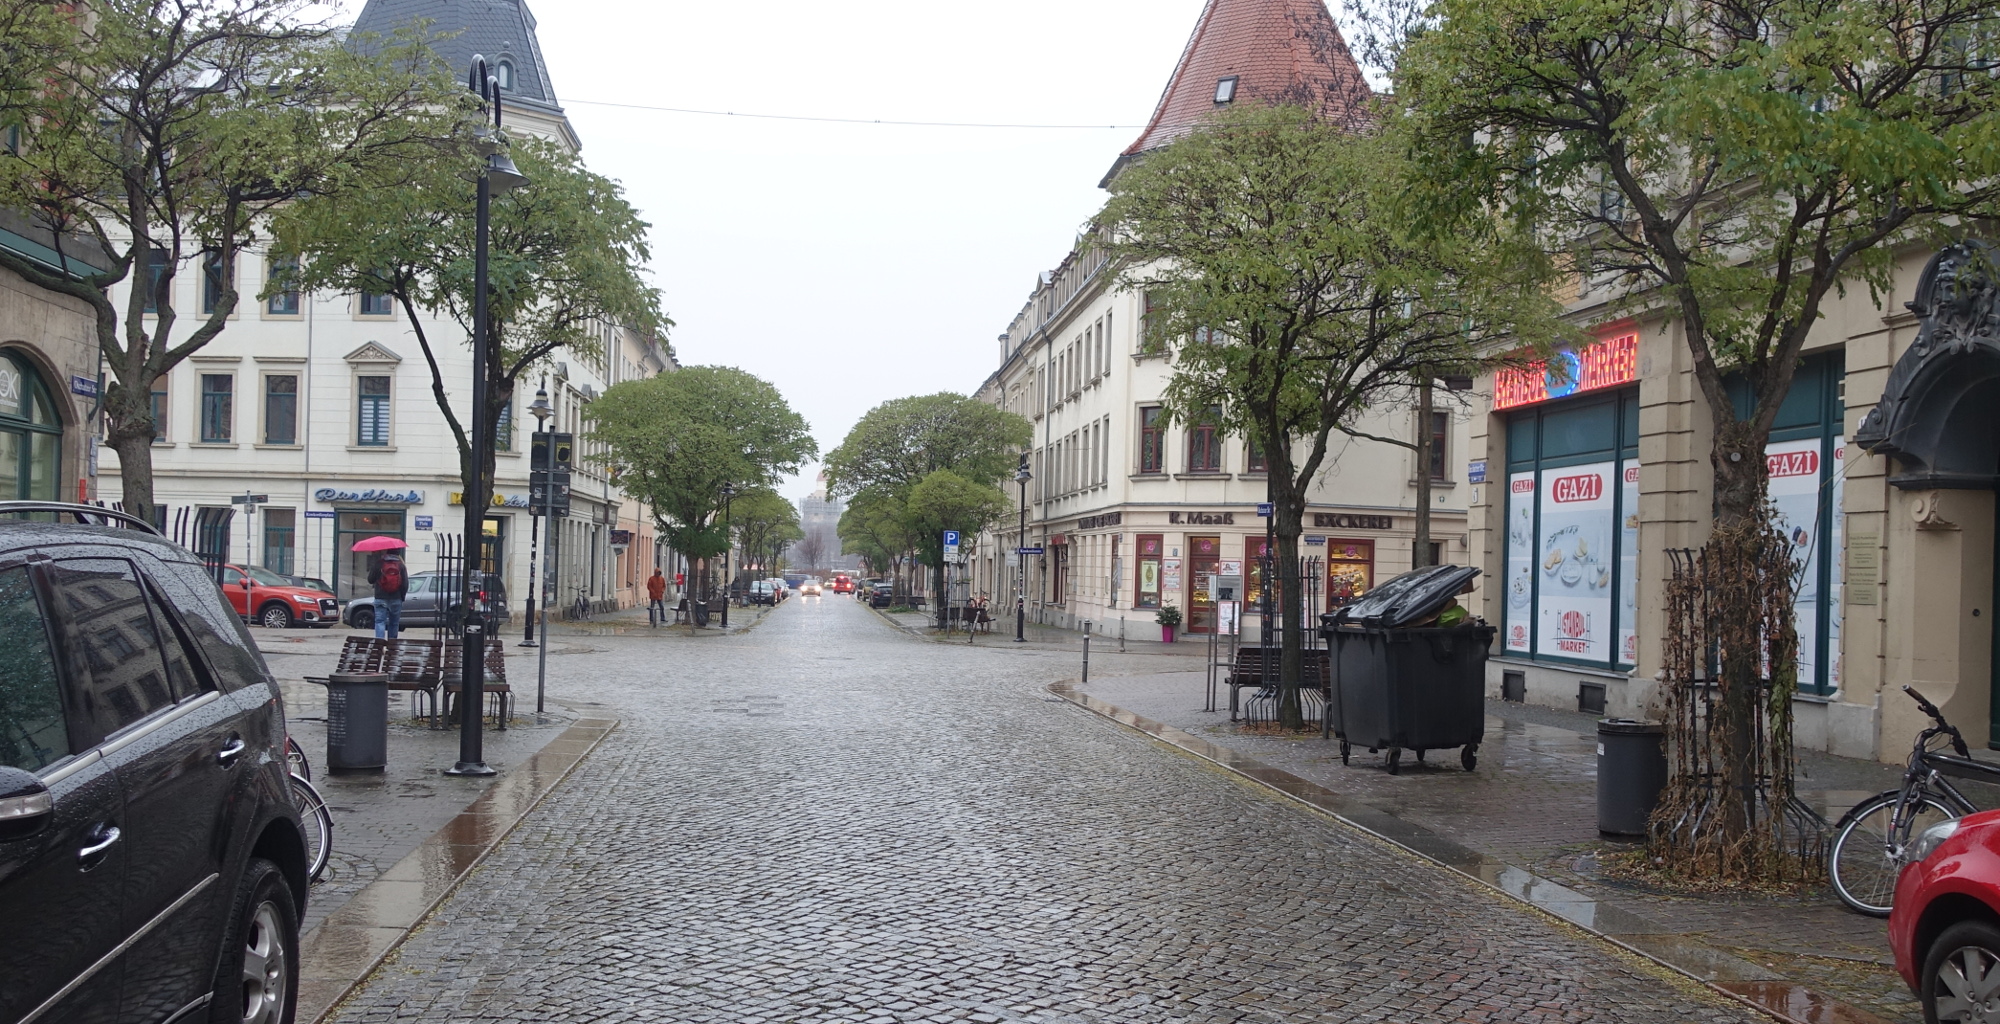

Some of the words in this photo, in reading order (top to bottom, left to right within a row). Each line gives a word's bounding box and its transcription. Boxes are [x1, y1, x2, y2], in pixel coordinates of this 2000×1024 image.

[1579, 333, 1638, 391] MARKET
[315, 488, 421, 503] Rundfunk
[947, 532, 956, 544] P
[1559, 641, 1586, 653] MARKET
